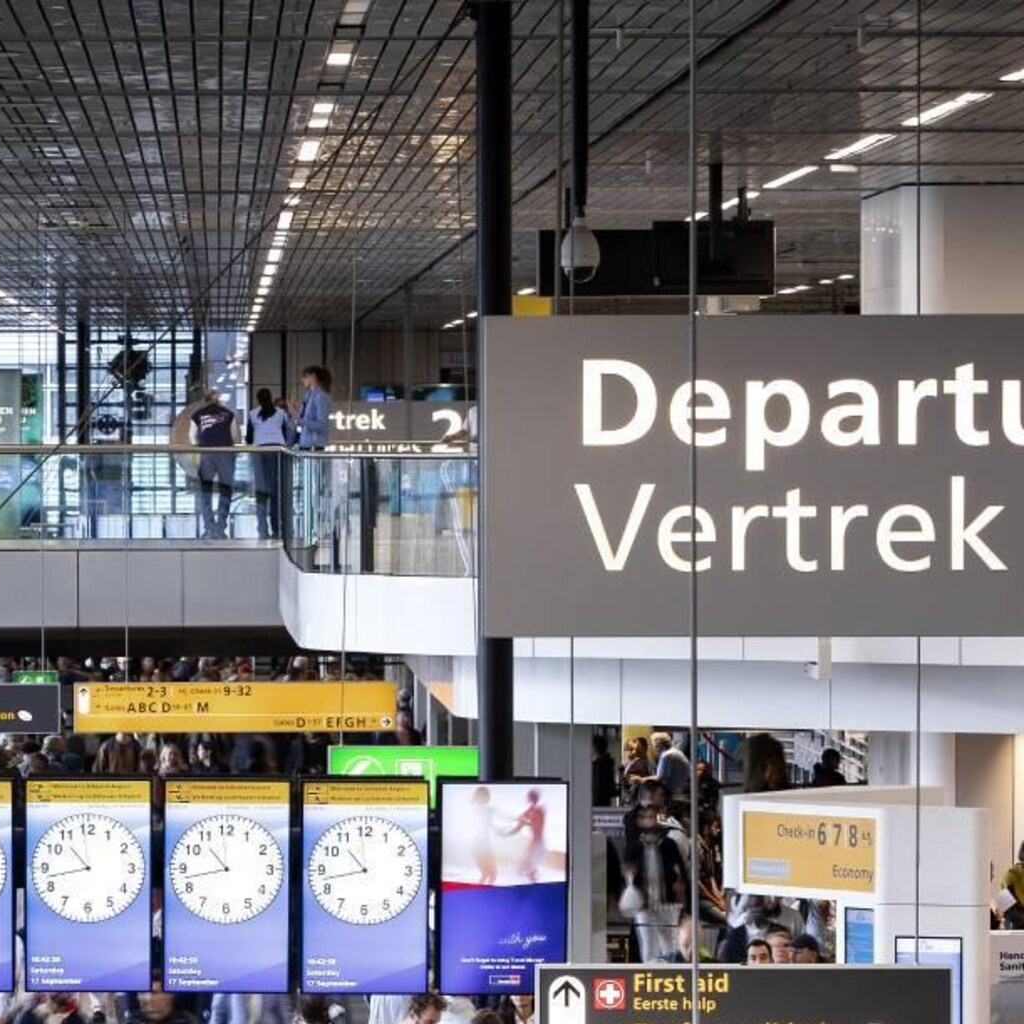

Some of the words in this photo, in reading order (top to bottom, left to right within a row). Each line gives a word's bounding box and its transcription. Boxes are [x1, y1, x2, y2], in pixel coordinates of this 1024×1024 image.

[575, 475, 1008, 573] Vertrek
[147, 687, 167, 697] 2-3
[224, 685, 251, 696] 9-32
[197, 703, 208, 712] M
[80, 824, 94, 834] 12
[218, 825, 233, 835] 12
[357, 827, 371, 837] 12
[60, 830, 72, 840] 11
[104, 830, 110, 840] 1
[199, 831, 211, 841] 11
[243, 831, 249, 841] 1
[337, 832, 349, 843] 11
[381, 832, 387, 843] 1
[818, 822, 826, 845] 6
[833, 824, 841, 846] 7
[849, 824, 857, 847] 8
[47, 843, 62, 854] 10
[120, 843, 128, 854] 2
[186, 844, 200, 855] 10
[258, 844, 267, 855] 2
[324, 846, 339, 856] 10
[397, 846, 405, 856] 2
[41, 862, 49, 873] 9
[128, 863, 136, 873] 3
[179, 863, 187, 874] 9
[266, 864, 274, 874] 3
[318, 865, 326, 875] 9
[404, 865, 412, 875] 3
[832, 864, 874, 883] Economy
[47, 881, 55, 892] 8
[120, 883, 128, 892] 4
[185, 882, 193, 893] 8
[258, 884, 266, 893] 4
[324, 884, 332, 894] 8
[396, 885, 405, 895] 4
[61, 895, 69, 906] 7
[107, 897, 114, 907] 5
[200, 896, 208, 907] 7
[245, 898, 253, 908] 5
[338, 898, 346, 908] 7
[384, 899, 391, 909] 5
[85, 902, 92, 912] 6
[223, 903, 231, 913] 6
[362, 904, 369, 915] 6
[633, 973, 685, 992] First
[697, 973, 729, 992] aid
[633, 997, 678, 1010] Eerste
[683, 997, 716, 1012] hlp
